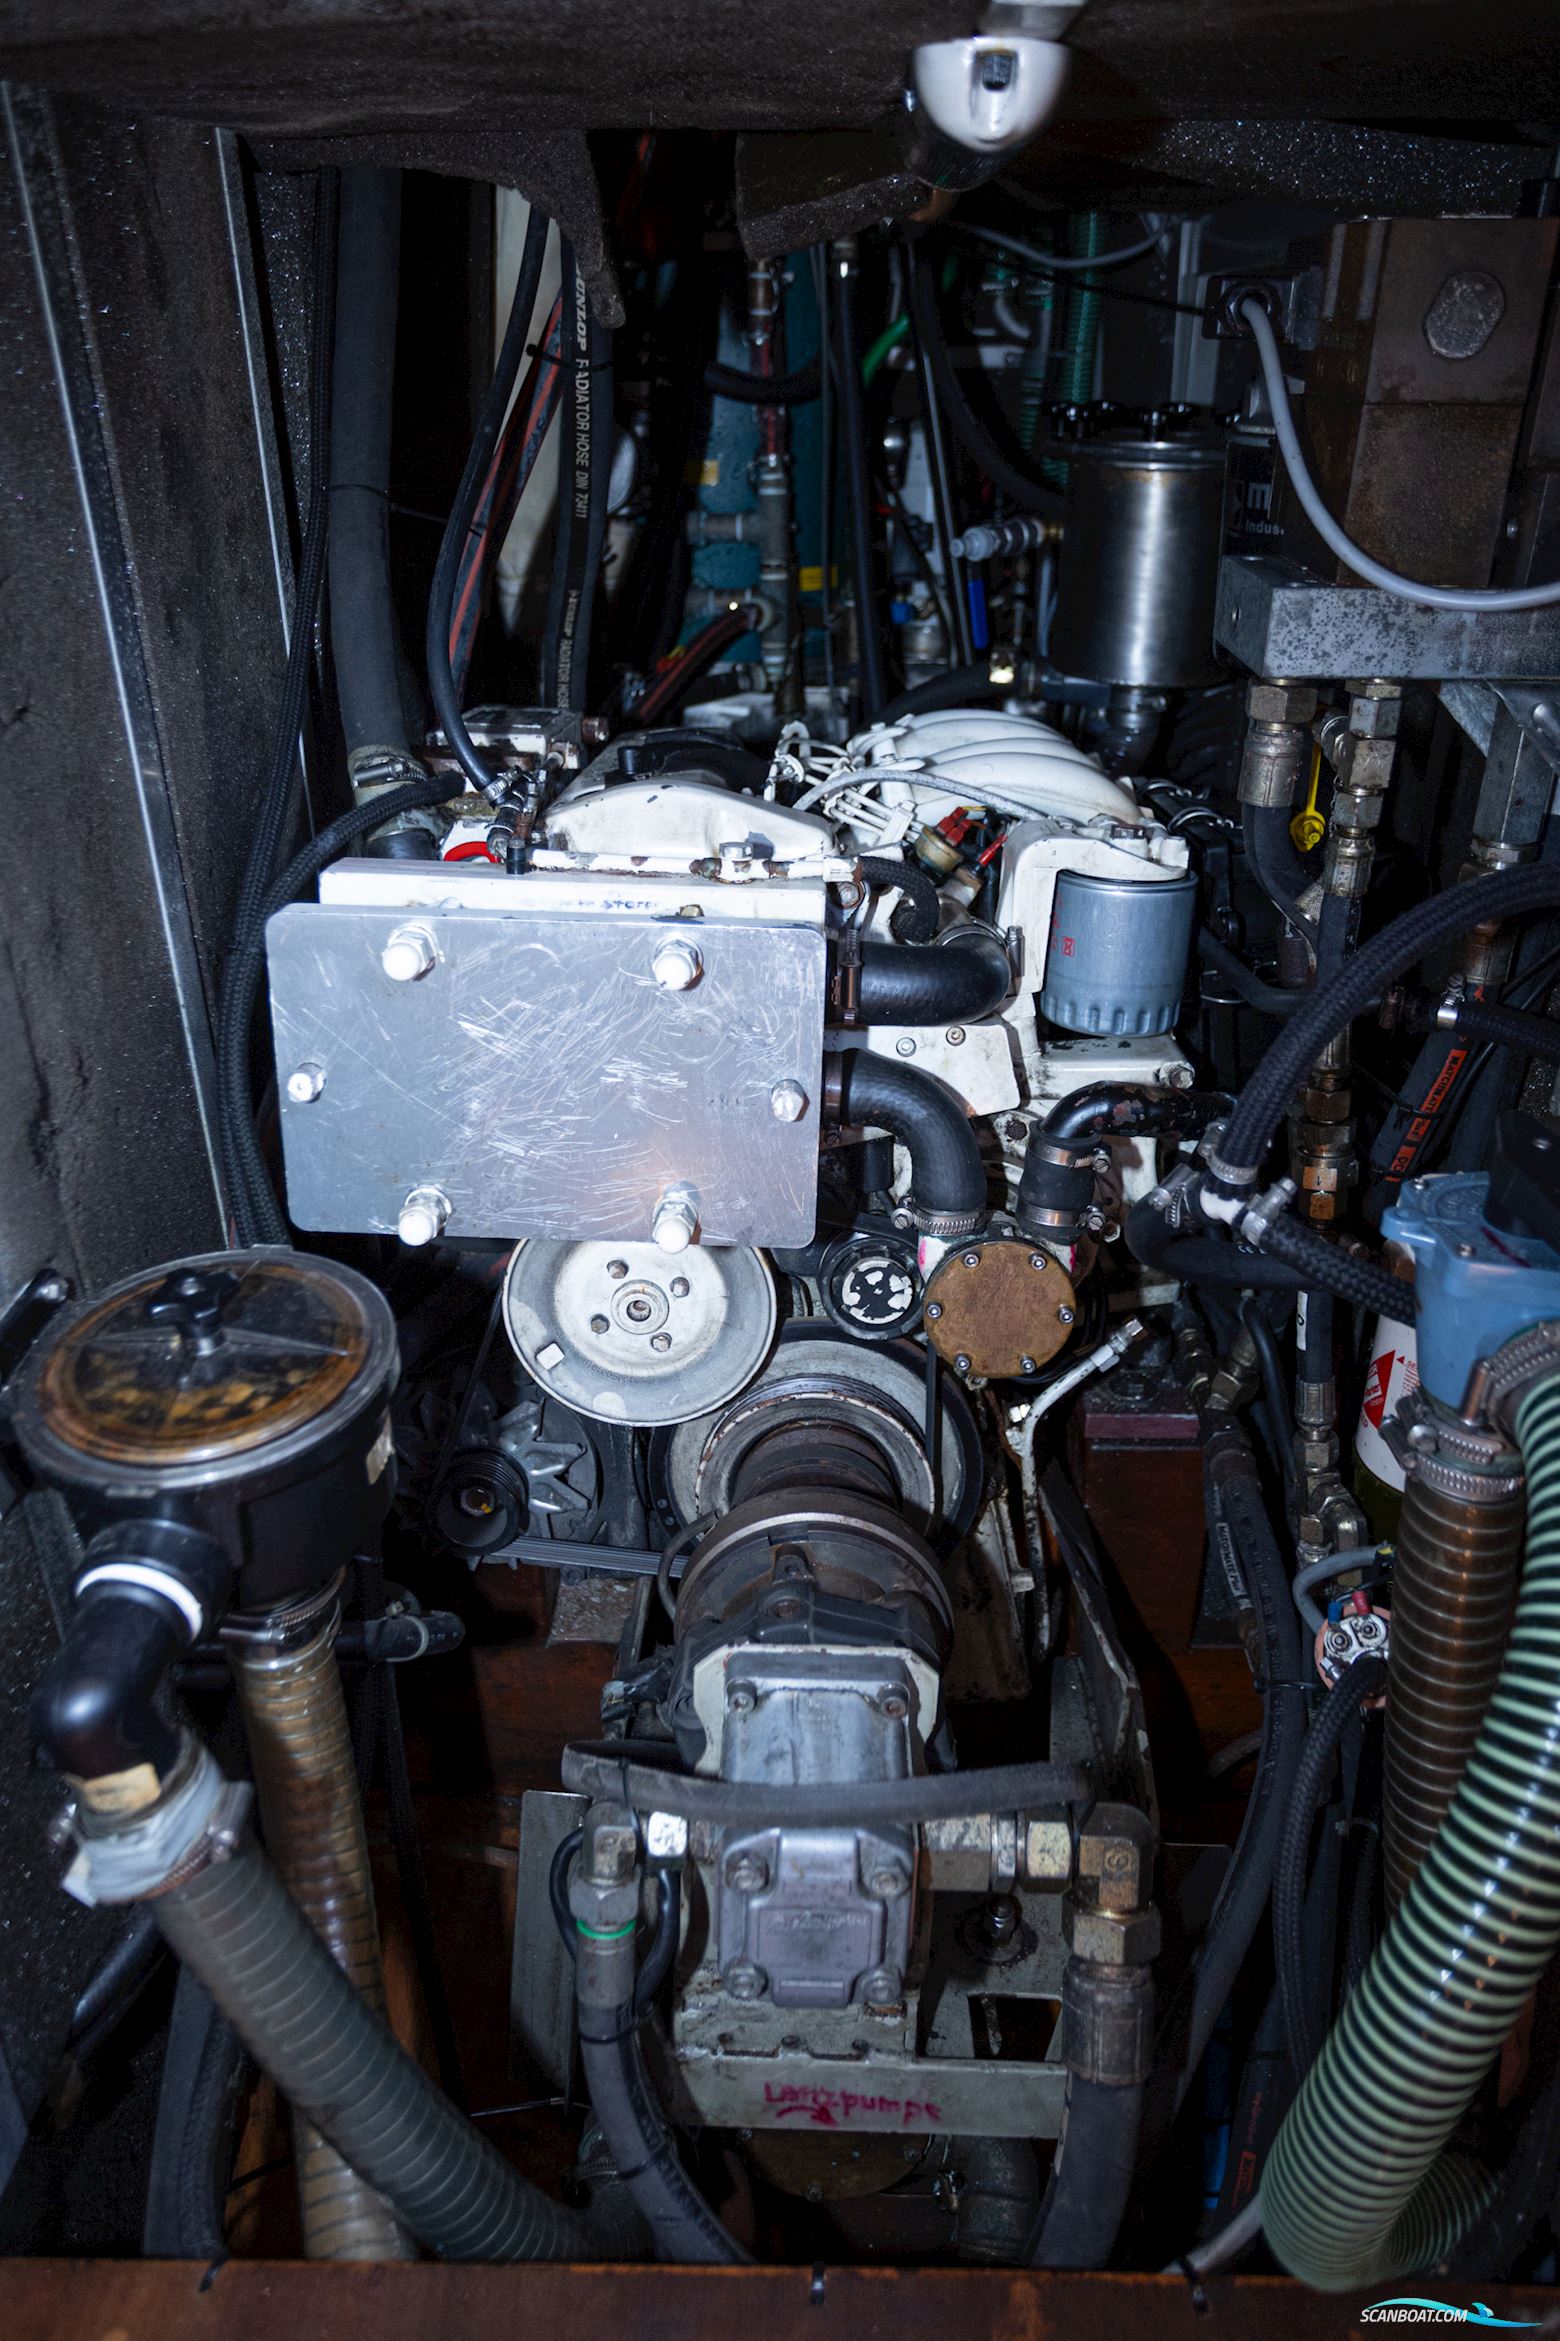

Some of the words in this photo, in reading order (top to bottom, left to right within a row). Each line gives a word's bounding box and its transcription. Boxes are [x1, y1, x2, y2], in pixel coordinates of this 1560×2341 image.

[575, 358, 590, 434] RADIATOR
[576, 432, 590, 466] HOSE
[575, 470, 590, 490] DIN
[575, 492, 590, 519] 73411
